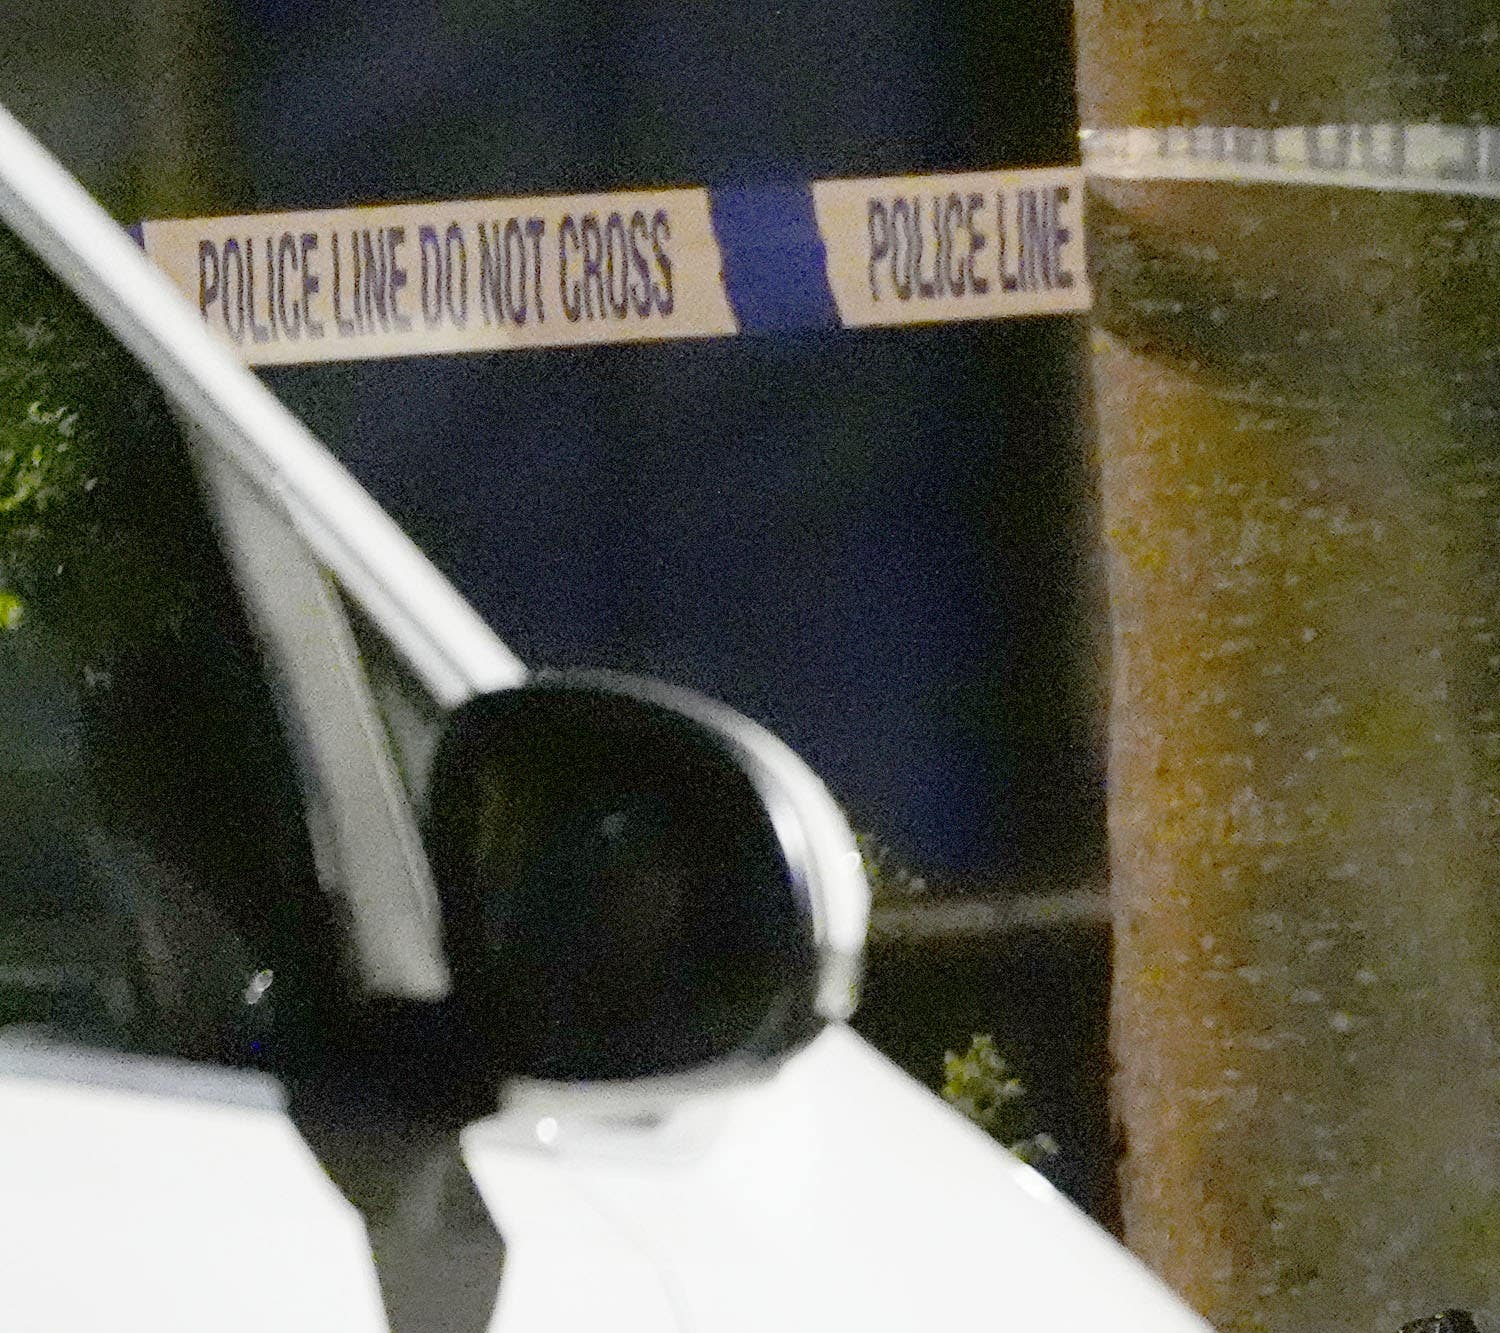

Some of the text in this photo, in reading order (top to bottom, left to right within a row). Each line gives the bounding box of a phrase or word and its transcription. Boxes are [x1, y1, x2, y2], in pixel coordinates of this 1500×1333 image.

[199, 208, 675, 345] POLICE LINE DO NOT CROSS
[870, 184, 1074, 302] POLICE LINE
